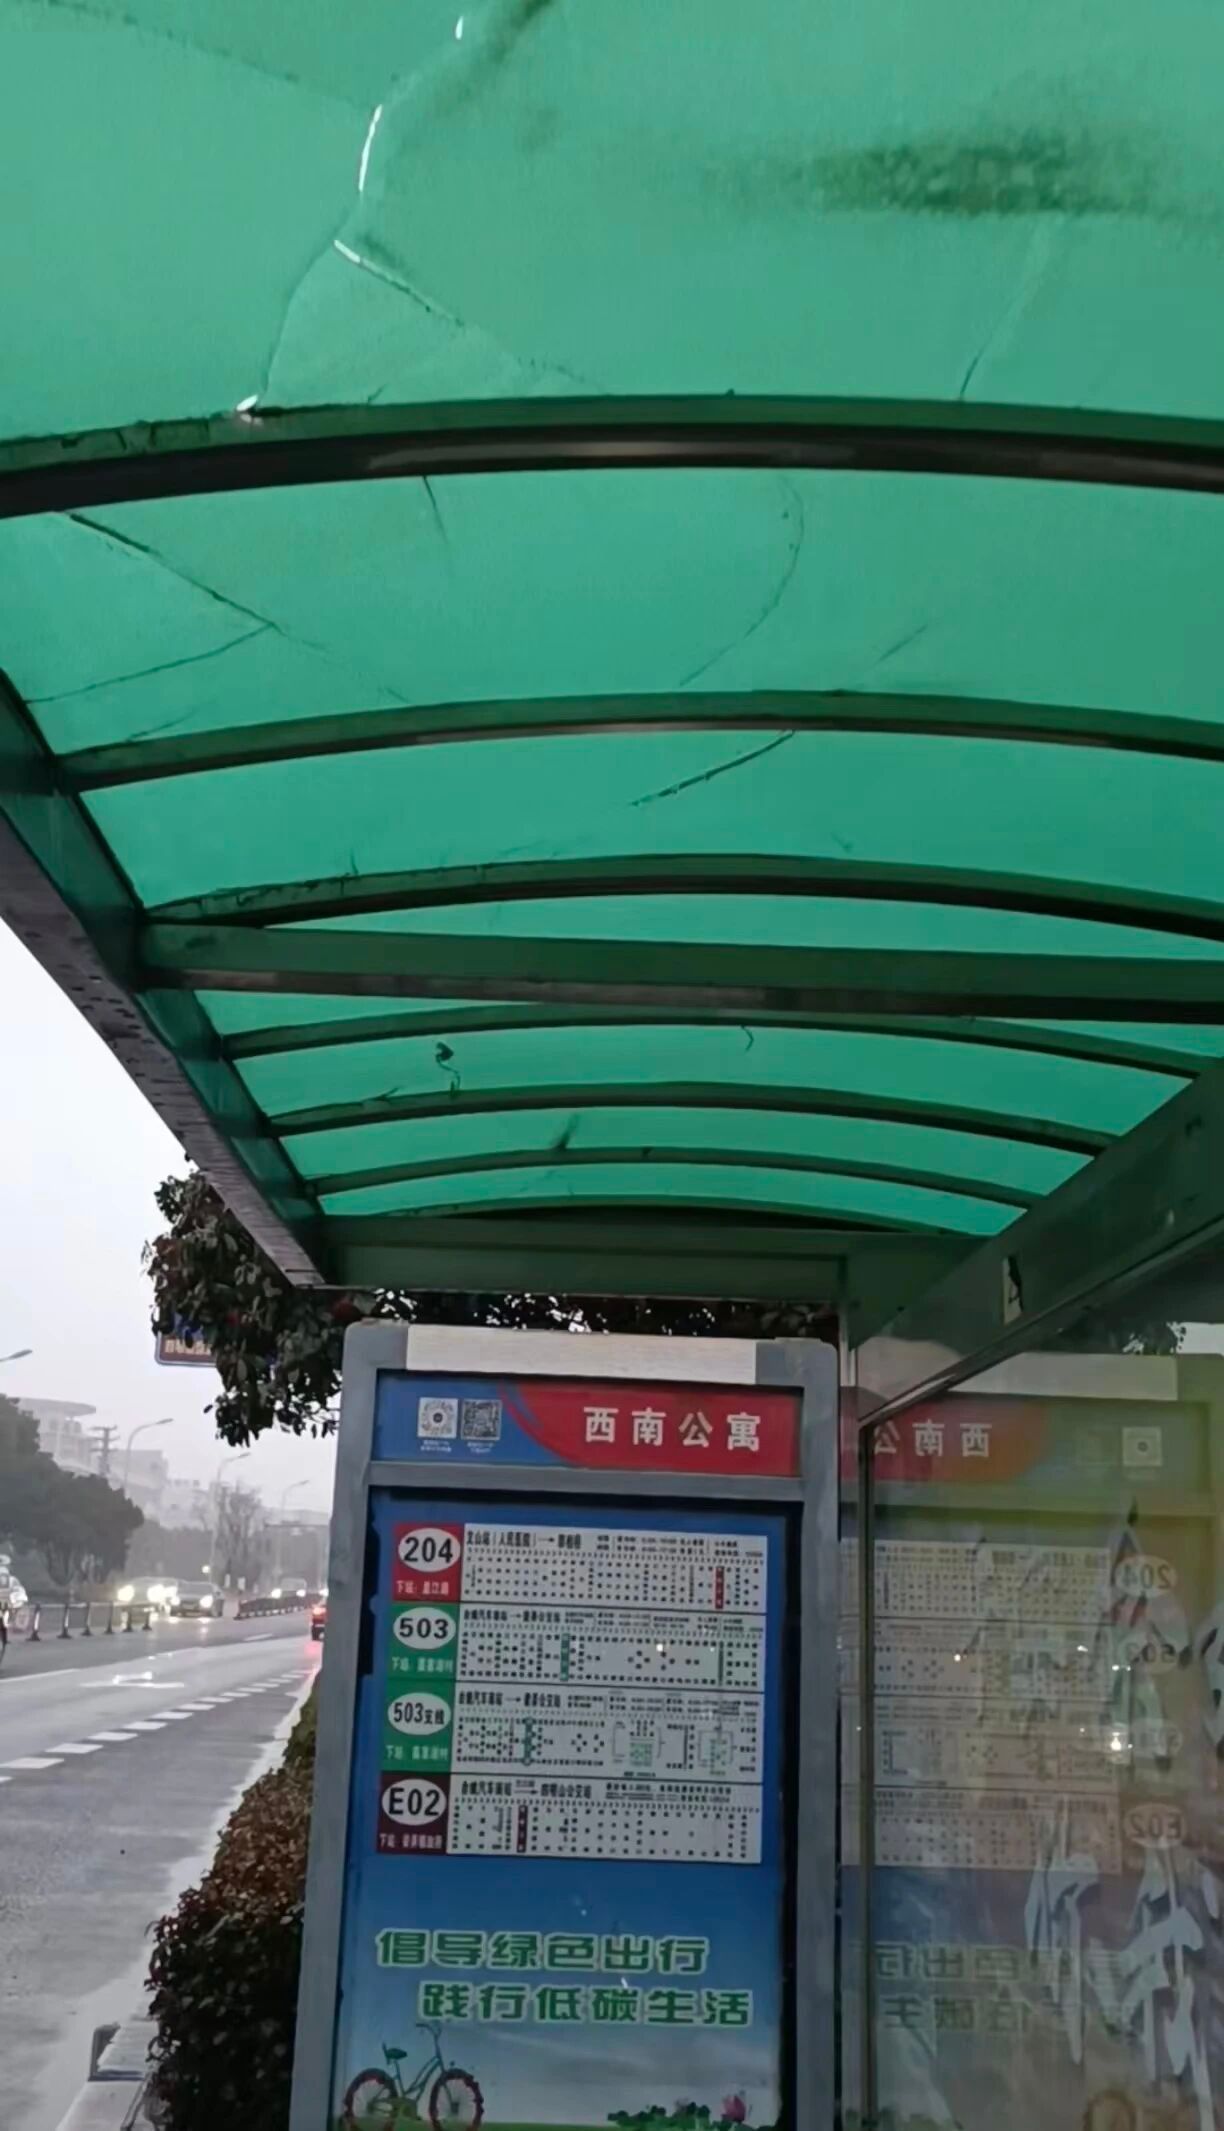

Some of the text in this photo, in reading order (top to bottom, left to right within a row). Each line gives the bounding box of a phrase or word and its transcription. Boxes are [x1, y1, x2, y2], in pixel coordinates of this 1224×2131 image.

[583, 1406, 762, 1452] 西南公寓
[404, 1537, 453, 1563] 204
[399, 1618, 449, 1639] 503
[393, 1702, 445, 1725] 503支线
[388, 1787, 440, 1816] E02
[376, 1928, 710, 1975] 倡导绿色出行
[418, 1980, 754, 2027] 践行低碳生活
